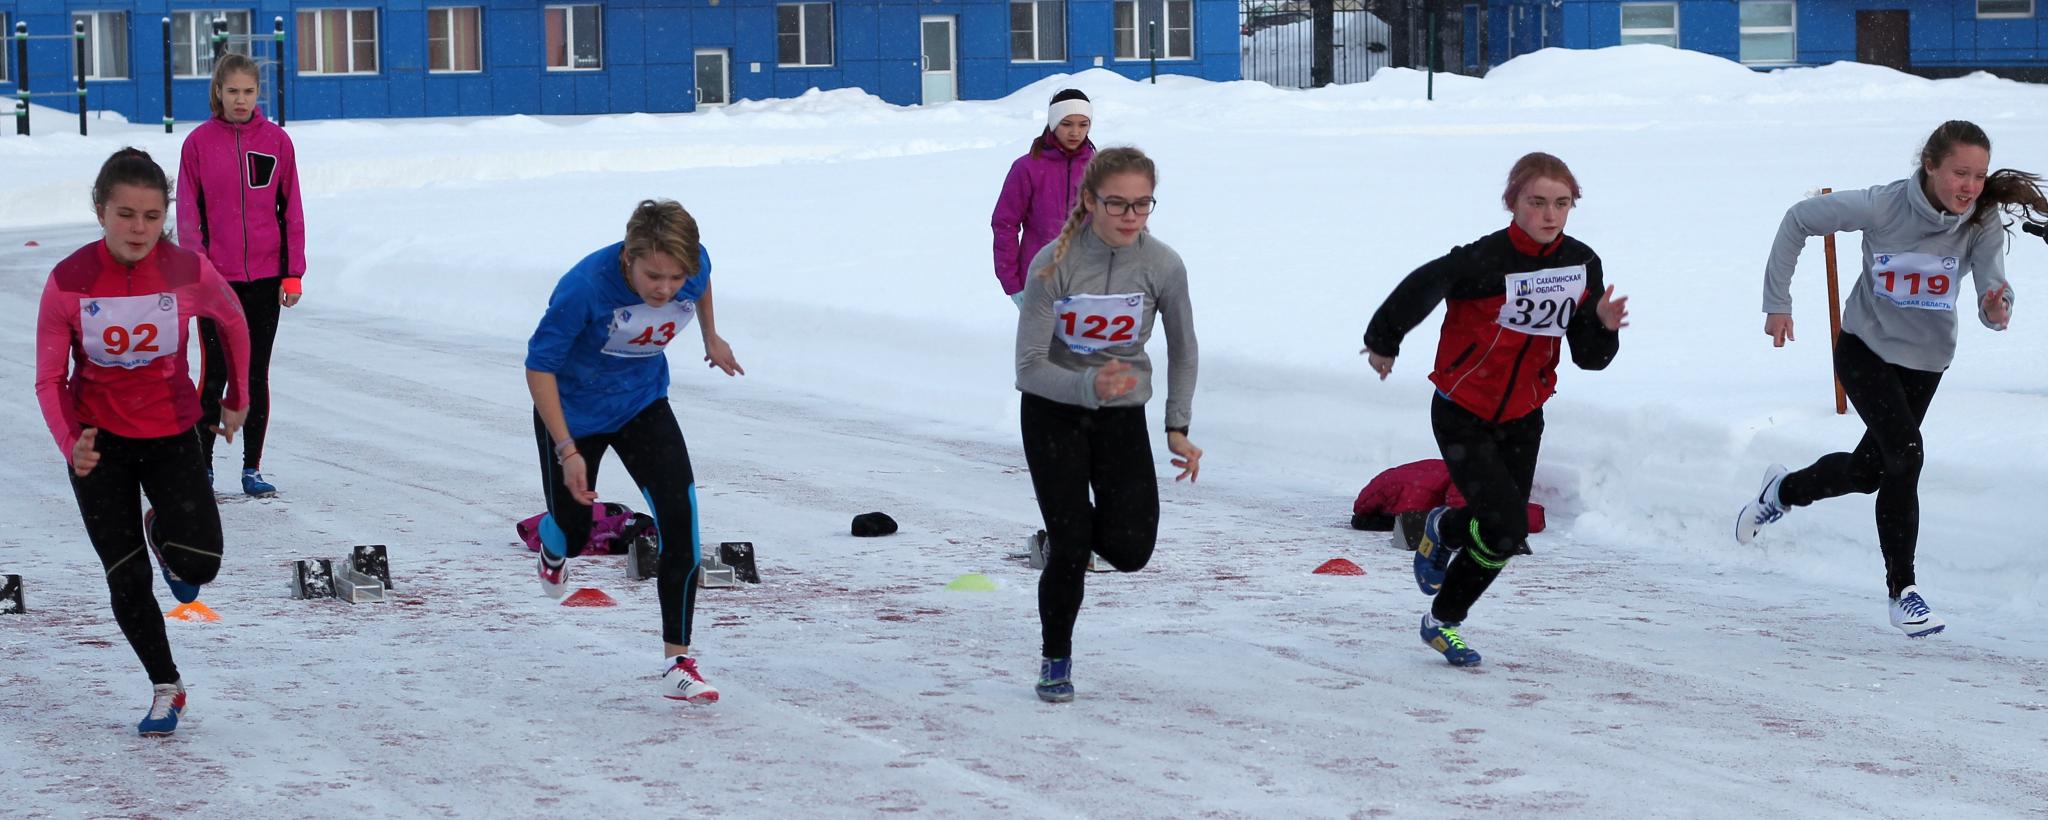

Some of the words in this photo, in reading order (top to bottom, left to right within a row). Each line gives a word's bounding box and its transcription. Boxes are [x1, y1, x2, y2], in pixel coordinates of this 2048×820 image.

[1535, 284, 1565, 294] ОБЛАСТЬ
[1536, 273, 1582, 285] САХАЛИНСКАЯ
[1878, 270, 1950, 295] 119
[1508, 296, 1577, 330] 320
[102, 323, 160, 355] 92
[627, 321, 676, 346] 43
[1060, 311, 1135, 342] 122
